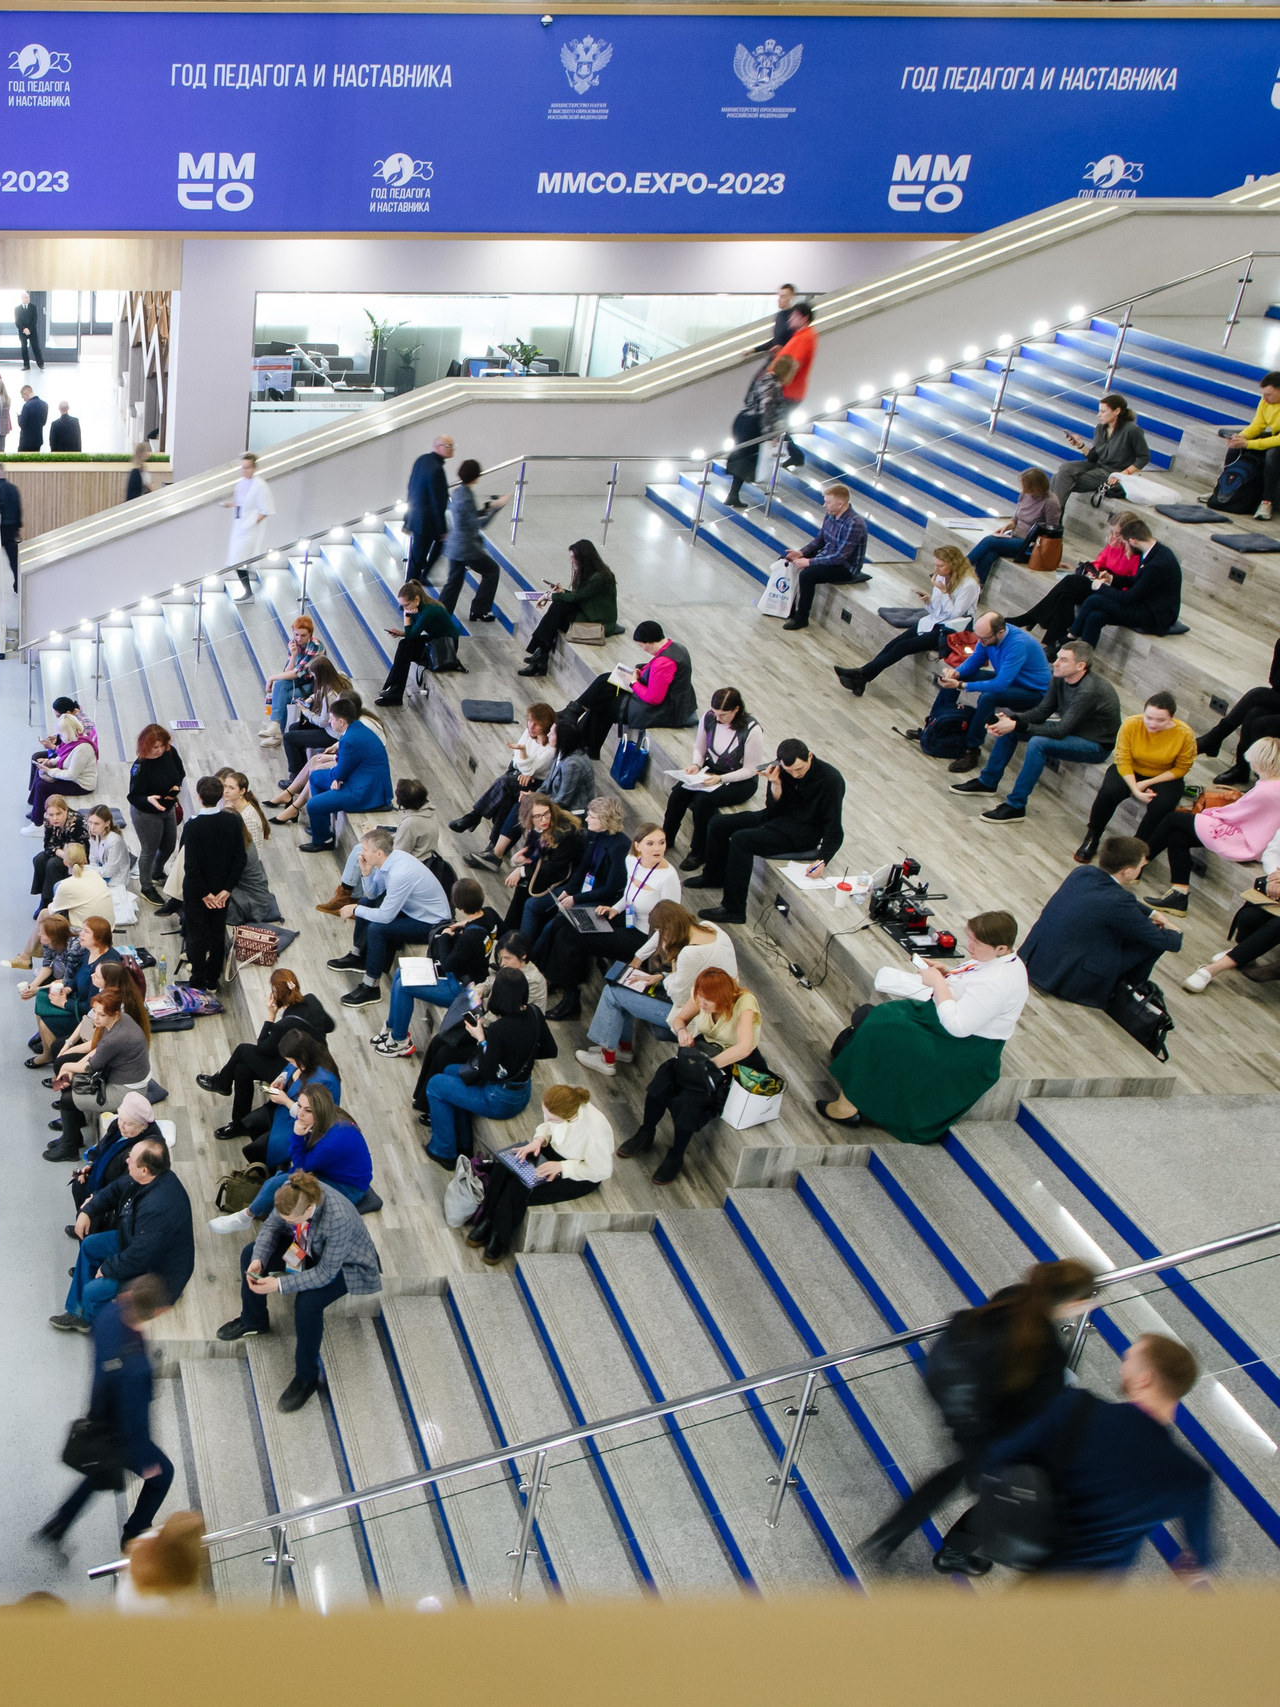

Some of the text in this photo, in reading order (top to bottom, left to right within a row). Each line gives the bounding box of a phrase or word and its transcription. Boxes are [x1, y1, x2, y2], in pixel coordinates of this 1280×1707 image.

[171, 63, 452, 90] ГОД ПЕДАГОГА И НАСТАВНИКА
[901, 66, 1178, 93] ГОД ПЕДАГОГА И НАСТАВНИКА
[8, 80, 71, 94] ГОД ПЕДАГОГА
[8, 95, 71, 107] И НАСТАВНИКА
[537, 172, 786, 195] MMCO.EXPO-2023
[370, 187, 431, 200] ГОД ПЕДАГОГА
[369, 201, 430, 213] И НАСТАВНИКА
